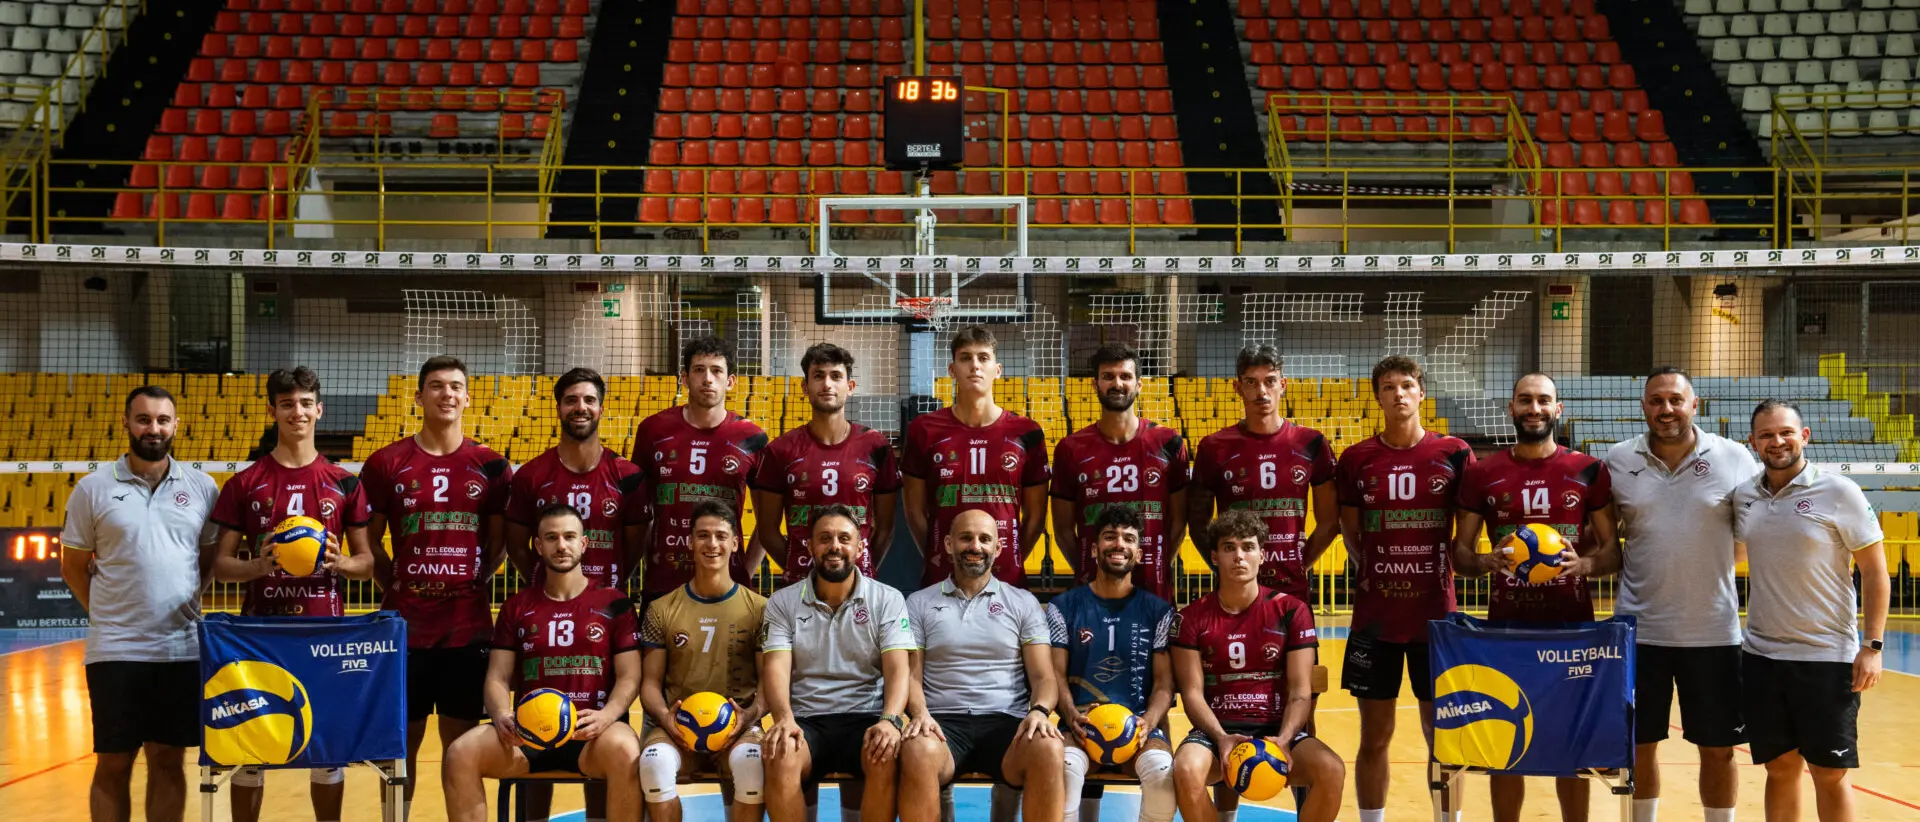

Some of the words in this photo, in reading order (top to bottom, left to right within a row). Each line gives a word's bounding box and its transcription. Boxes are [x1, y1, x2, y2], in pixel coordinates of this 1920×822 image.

[899, 81, 919, 100] 18
[931, 81, 957, 100] 36
[689, 448, 707, 475] 5
[969, 447, 987, 475] 11
[433, 475, 449, 502] 2
[822, 468, 839, 497] 3
[1106, 464, 1139, 493] 23
[1260, 461, 1277, 490] 6
[1388, 472, 1416, 500] 10
[287, 493, 305, 516] 4
[567, 492, 592, 520] 18
[1521, 487, 1551, 515] 14
[407, 563, 467, 576] CANALE
[1375, 562, 1434, 574] CANALE
[263, 586, 326, 598] CANALE
[548, 619, 575, 647] 13
[700, 626, 716, 653] 7
[1108, 624, 1115, 651] 1
[310, 640, 398, 658] VOLLEYBALL
[1228, 641, 1246, 669] 9
[1536, 645, 1622, 663] VOLLEYBALL
